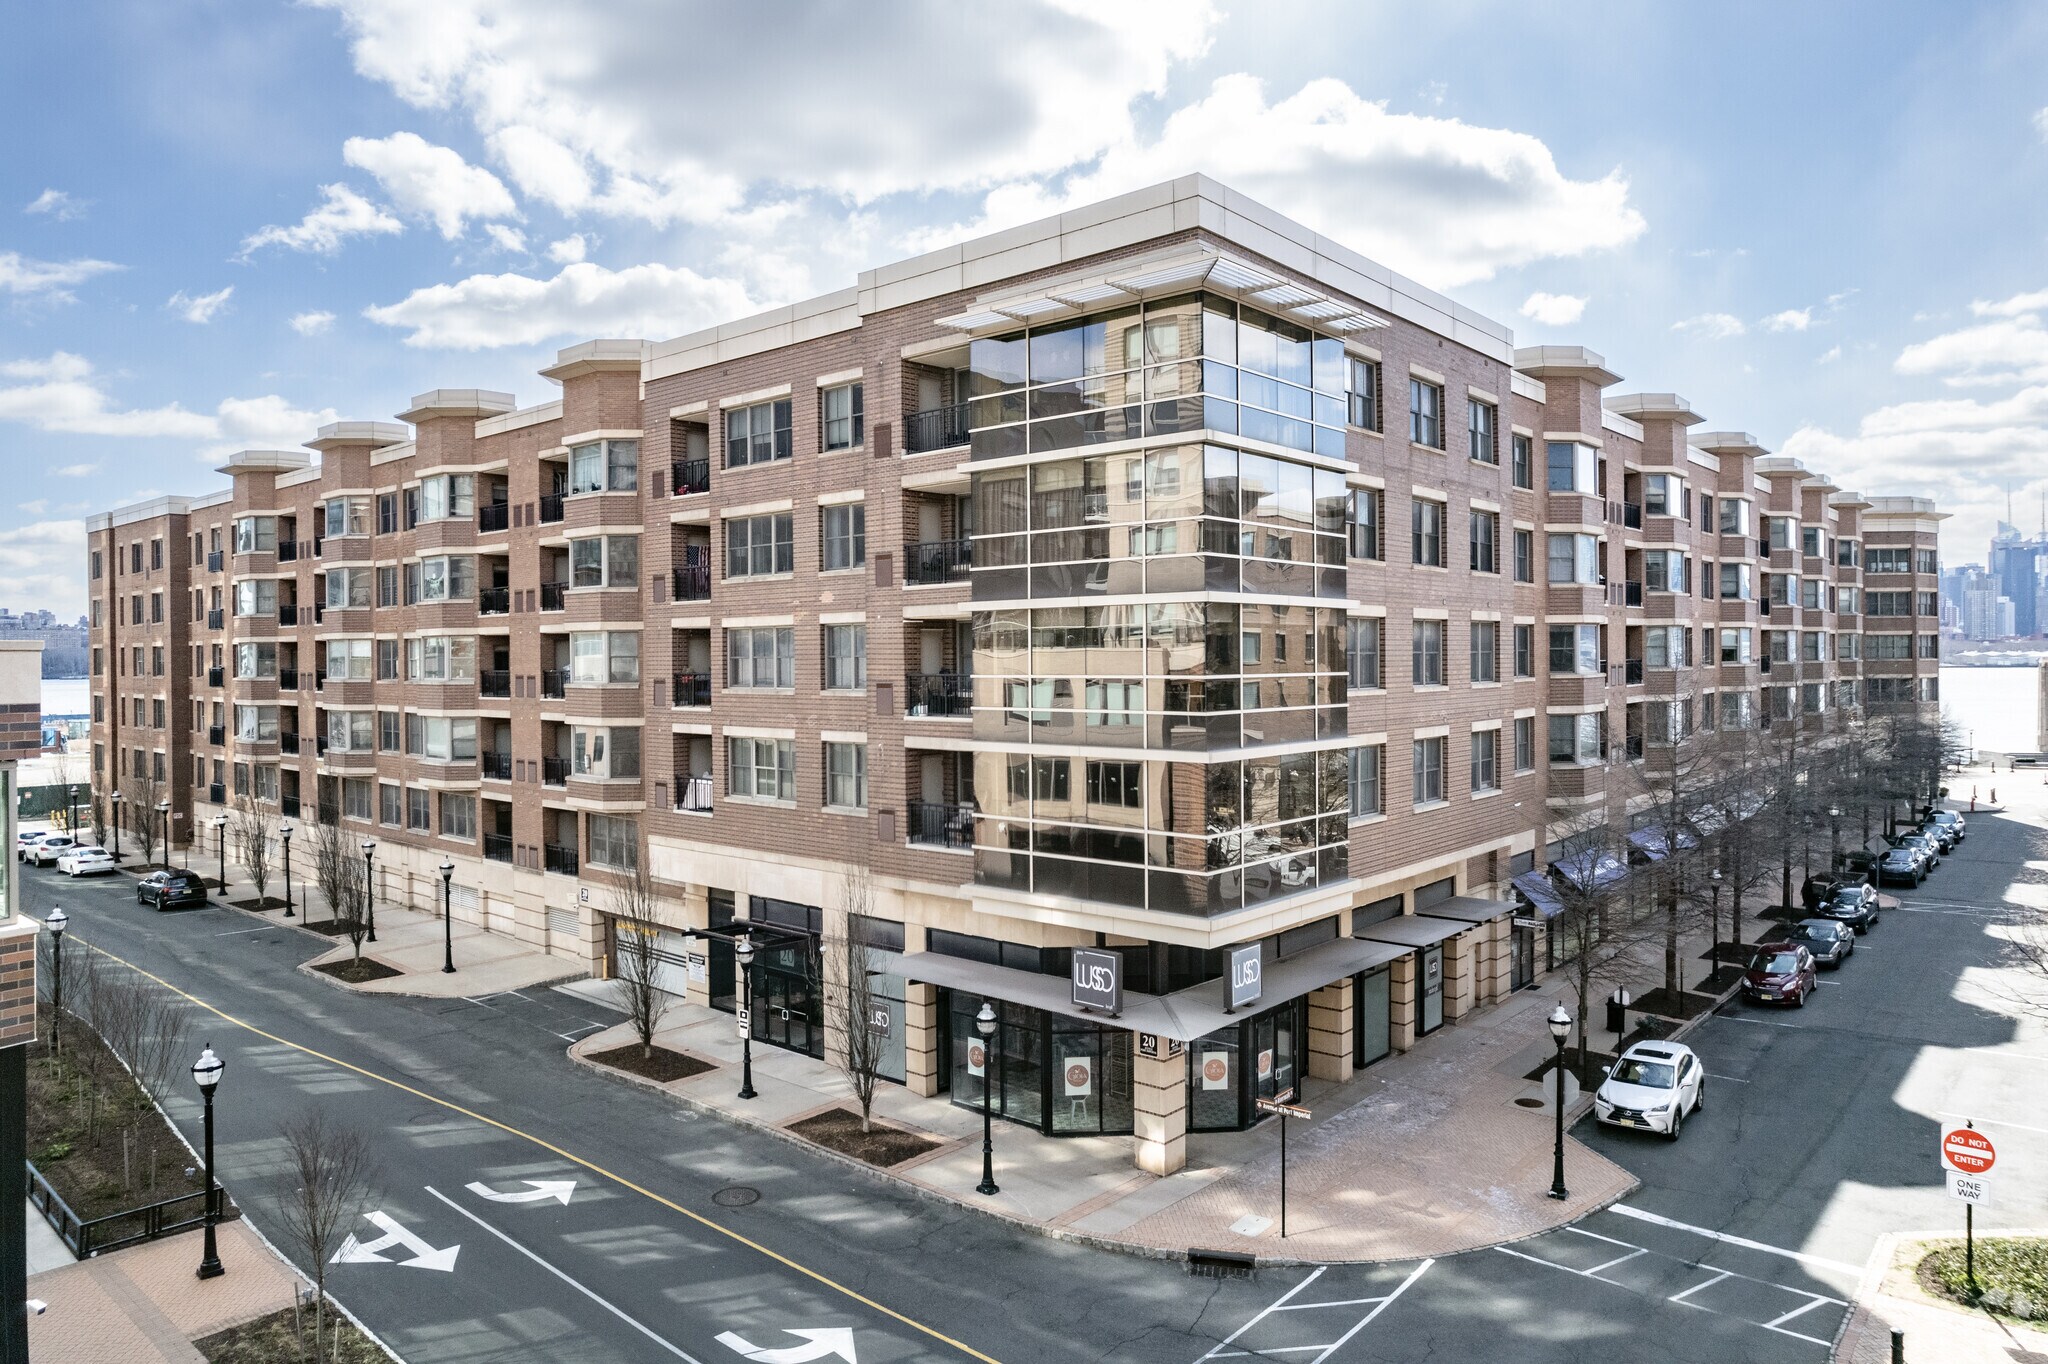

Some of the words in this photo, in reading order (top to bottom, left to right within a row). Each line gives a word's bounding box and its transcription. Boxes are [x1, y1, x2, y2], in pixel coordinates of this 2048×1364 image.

[781, 949, 795, 964] 20
[1076, 962, 1114, 992] LUSSO
[1233, 958, 1260, 988] LUSSO
[1142, 1035, 1155, 1048] 20
[1950, 1135, 1965, 1144] DO
[1968, 1138, 1988, 1149] NOT
[1954, 1155, 1985, 1167] ENTER
[1957, 1179, 1982, 1192] ONE
[1957, 1188, 1981, 1200] WAY
